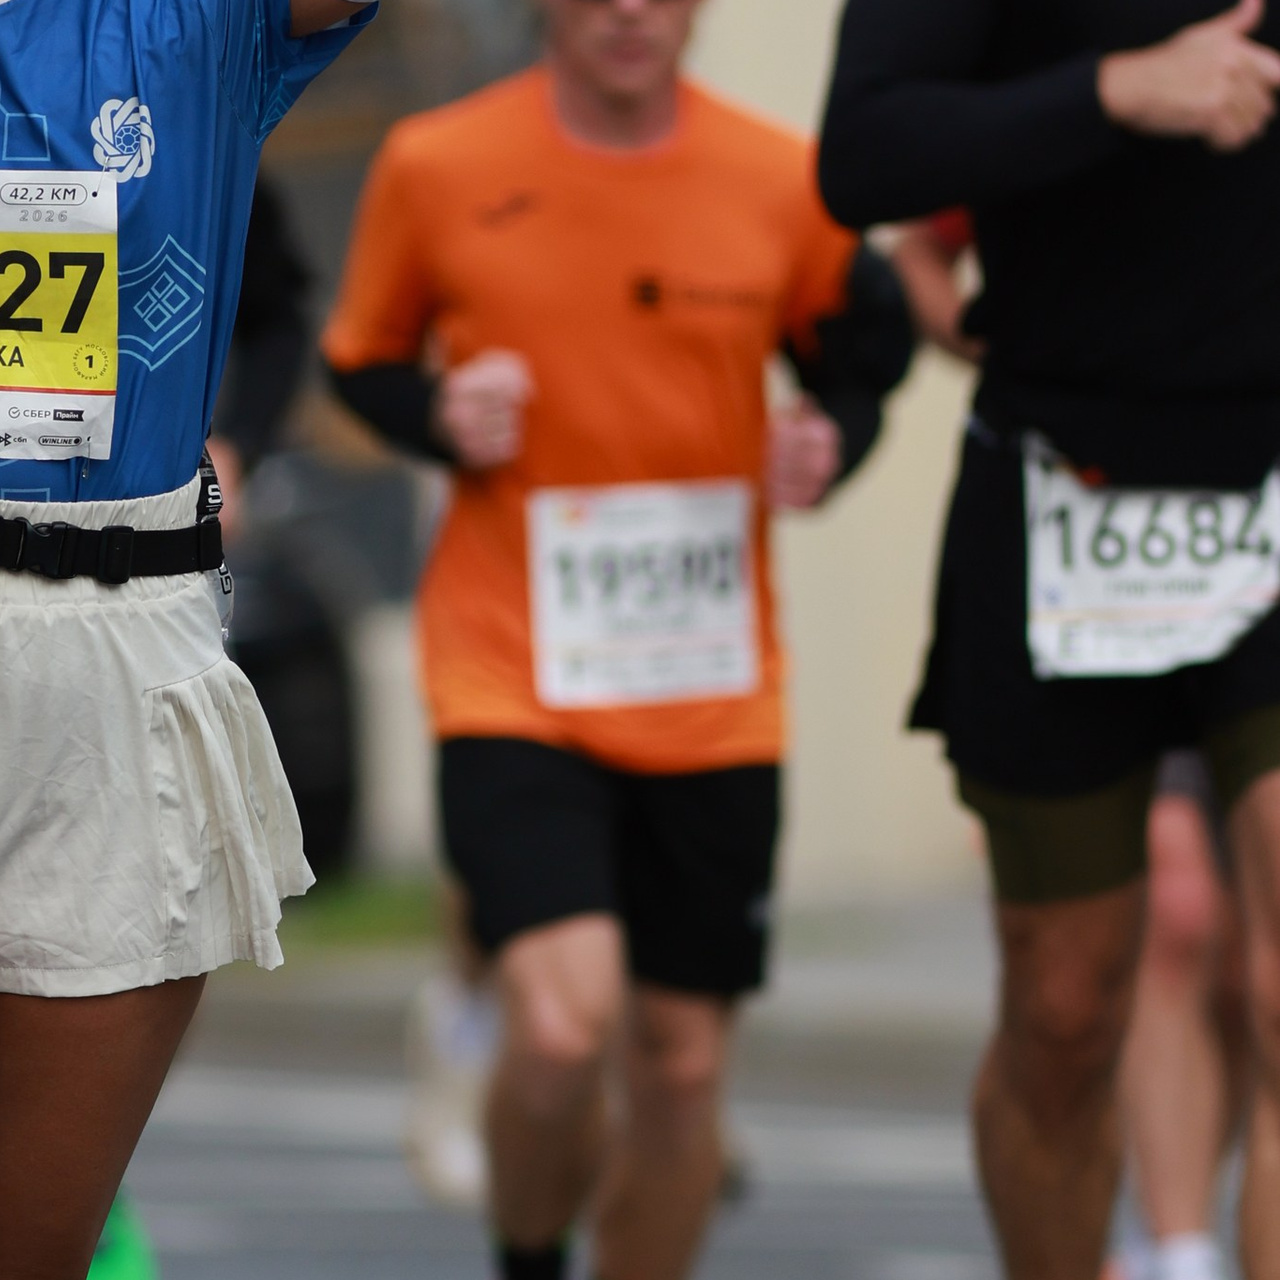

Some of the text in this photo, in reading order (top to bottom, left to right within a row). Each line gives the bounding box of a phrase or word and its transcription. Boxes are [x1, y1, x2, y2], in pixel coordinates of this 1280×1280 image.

[9, 187, 44, 202] 42,2
[19, 209, 68, 223] 2026
[85, 354, 94, 369] 1
[23, 409, 80, 420] СБЕР Прайм
[41, 437, 74, 445] WINLINE
[1043, 493, 1274, 574] 16684
